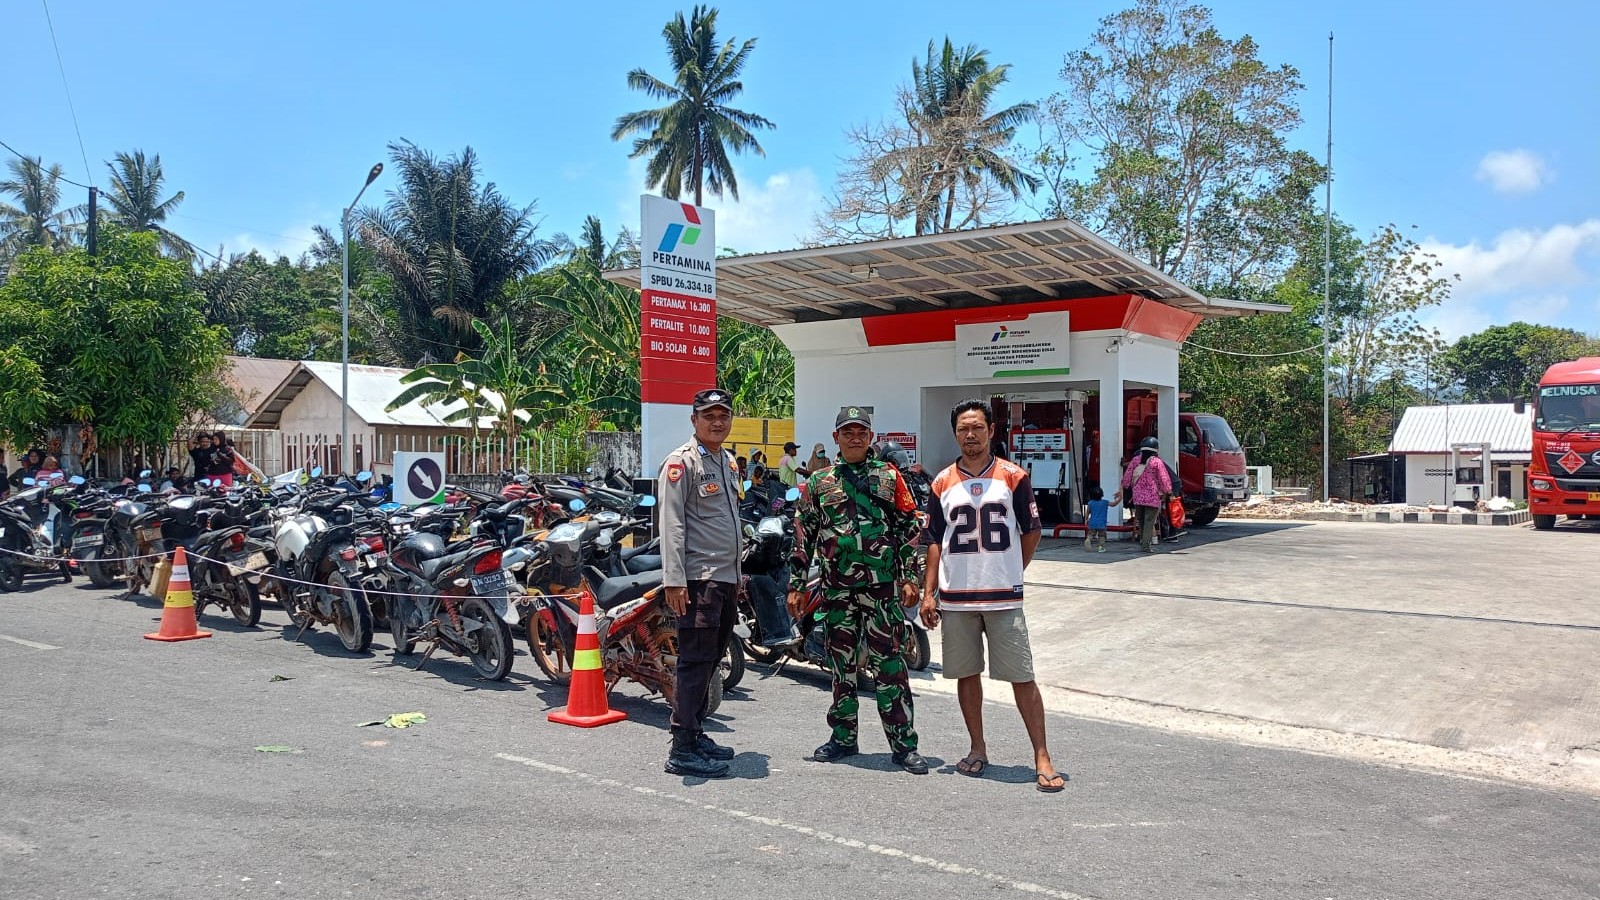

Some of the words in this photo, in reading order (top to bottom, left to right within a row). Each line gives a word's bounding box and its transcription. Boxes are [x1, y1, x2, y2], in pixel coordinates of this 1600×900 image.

[652, 251, 711, 272] PERTAMINA
[651, 274, 673, 287] SPBU
[674, 278, 713, 294] 26.334.18
[651, 295, 687, 310] PERTAMAX
[689, 301, 711, 313] 16.300
[650, 317, 684, 332] PERTALITE
[689, 323, 710, 336] 10.000
[651, 340, 664, 352] BIO
[665, 342, 687, 354] SOLAR
[692, 345, 710, 356] 6.800
[1546, 385, 1597, 396] ELNUSA
[949, 502, 1012, 554] 26
